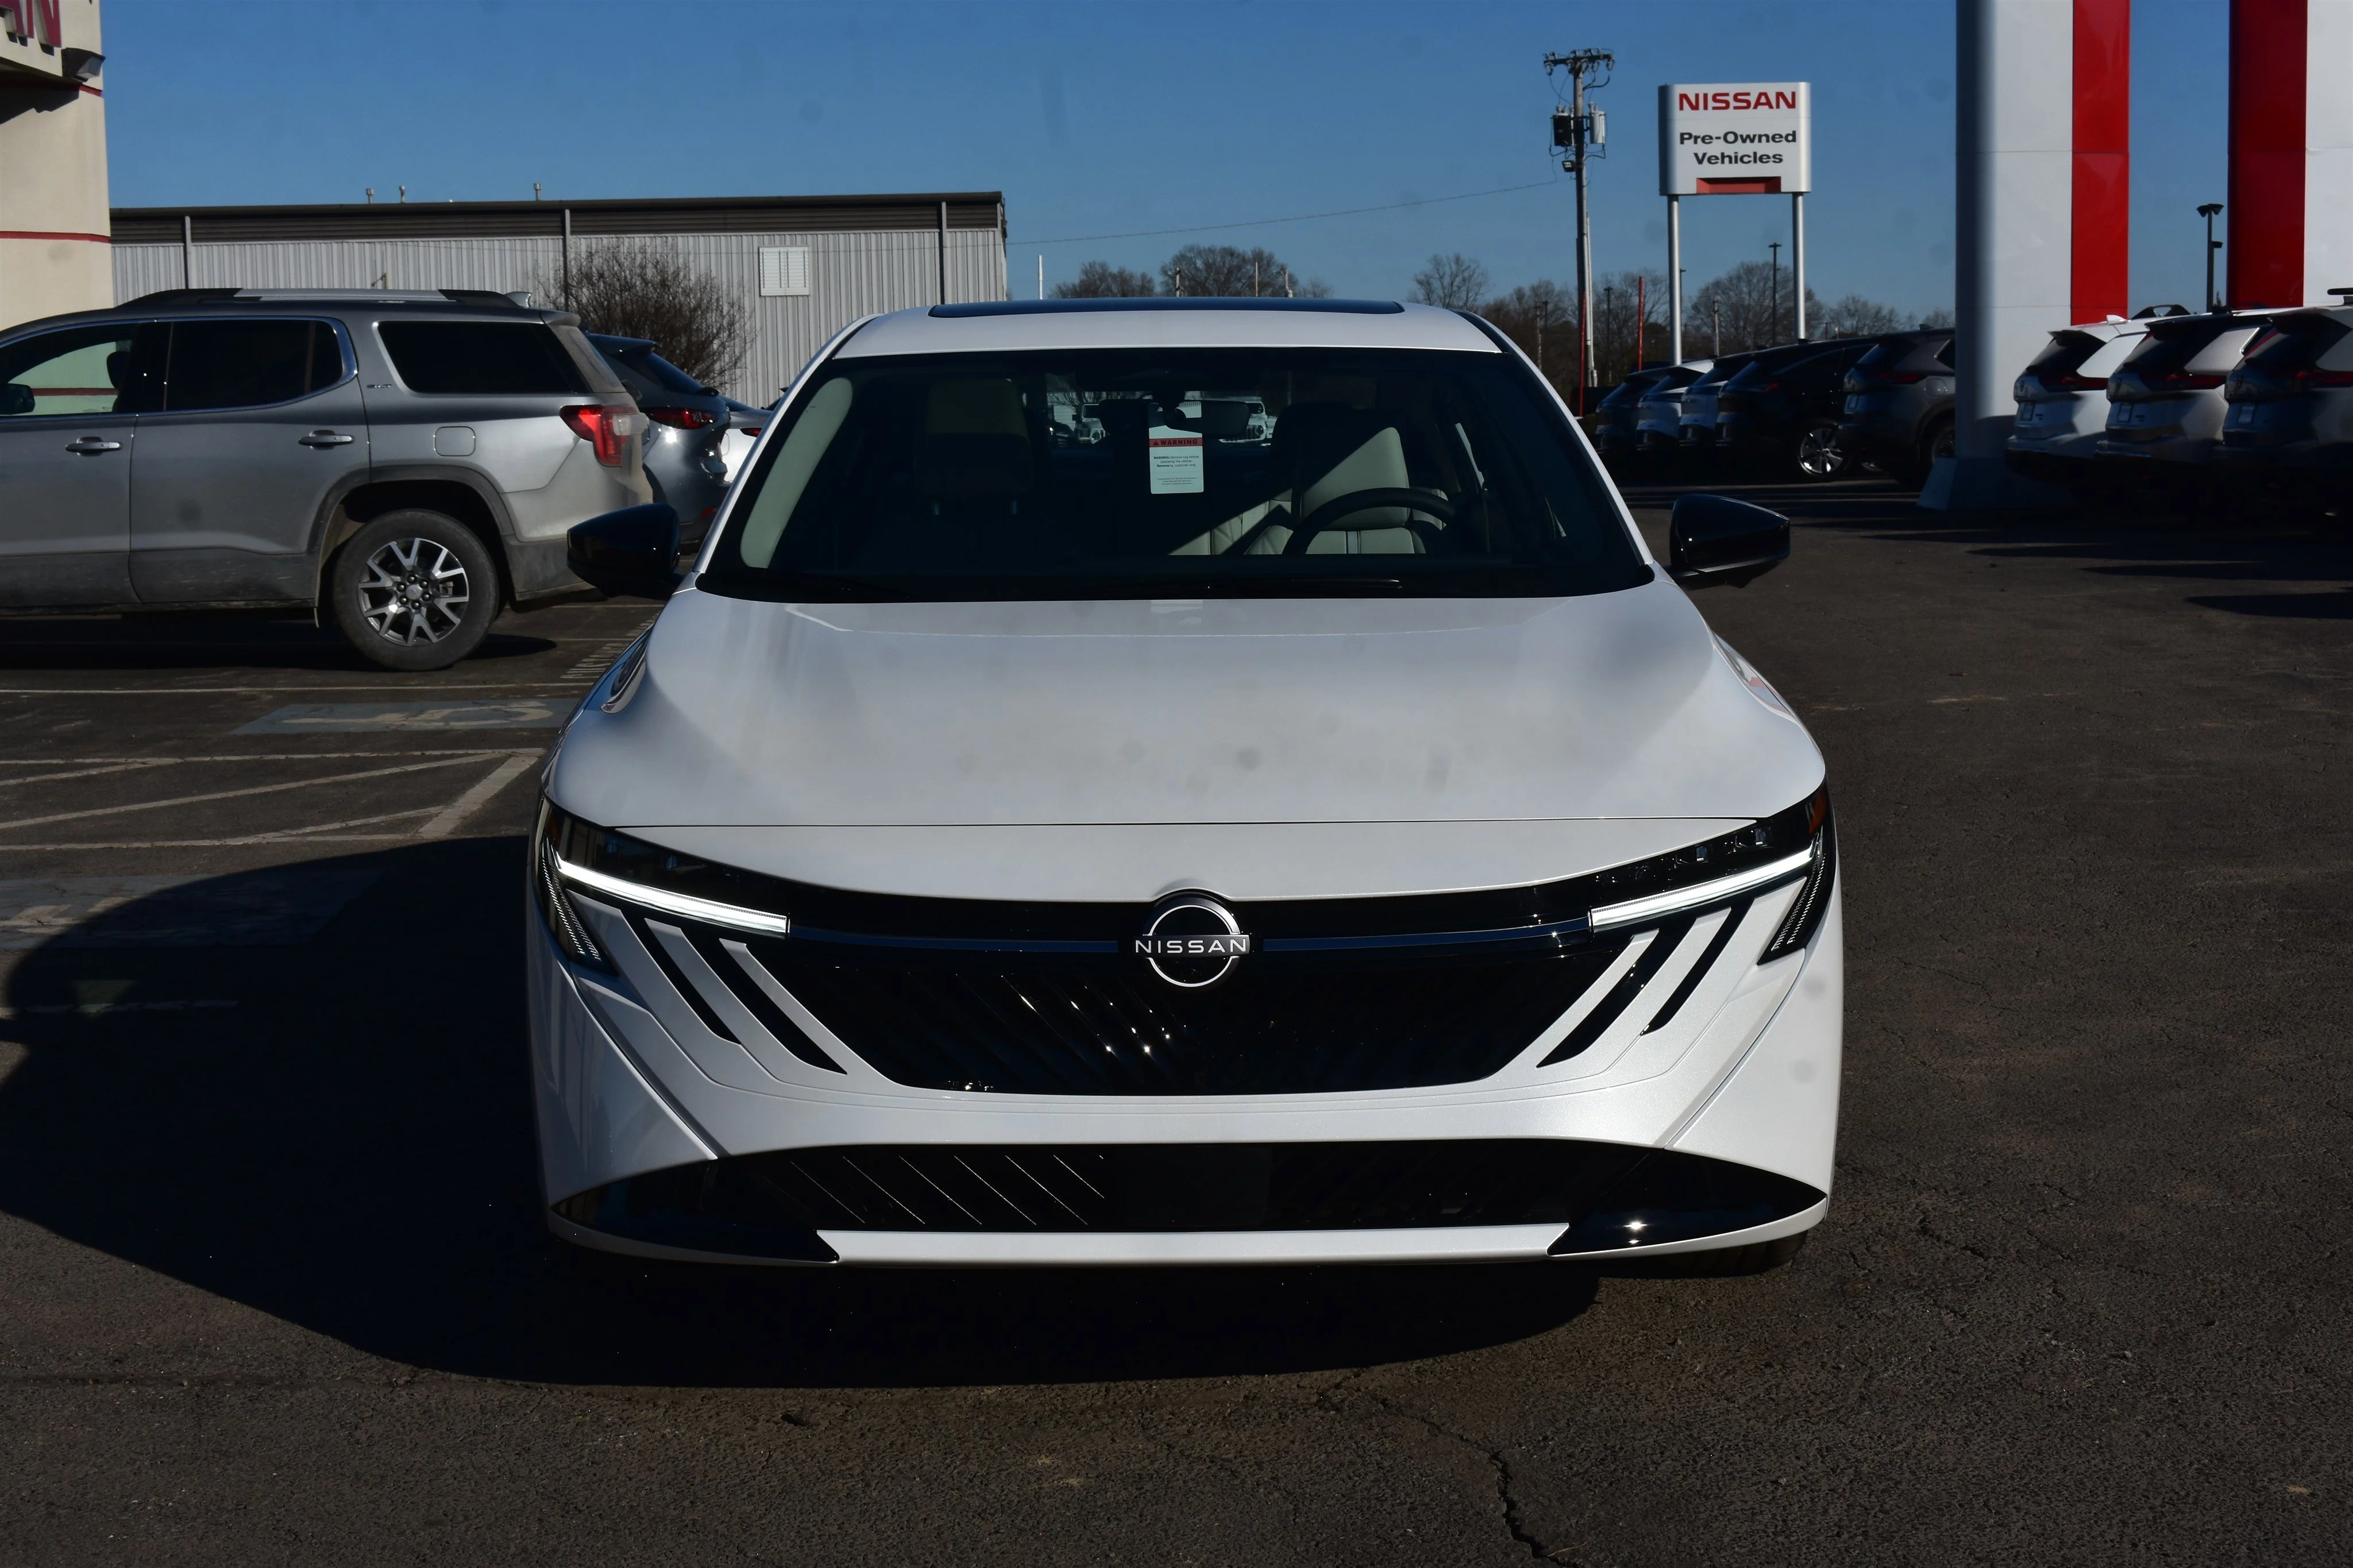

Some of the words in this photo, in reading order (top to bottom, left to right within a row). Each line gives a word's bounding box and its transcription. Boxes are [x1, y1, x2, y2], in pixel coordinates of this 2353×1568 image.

[1679, 91, 1796, 111] NISSAN
[1679, 130, 1797, 145] Pre-Owned
[1693, 152, 1784, 165] Vehicles
[1135, 939, 1247, 953] NISSAN
